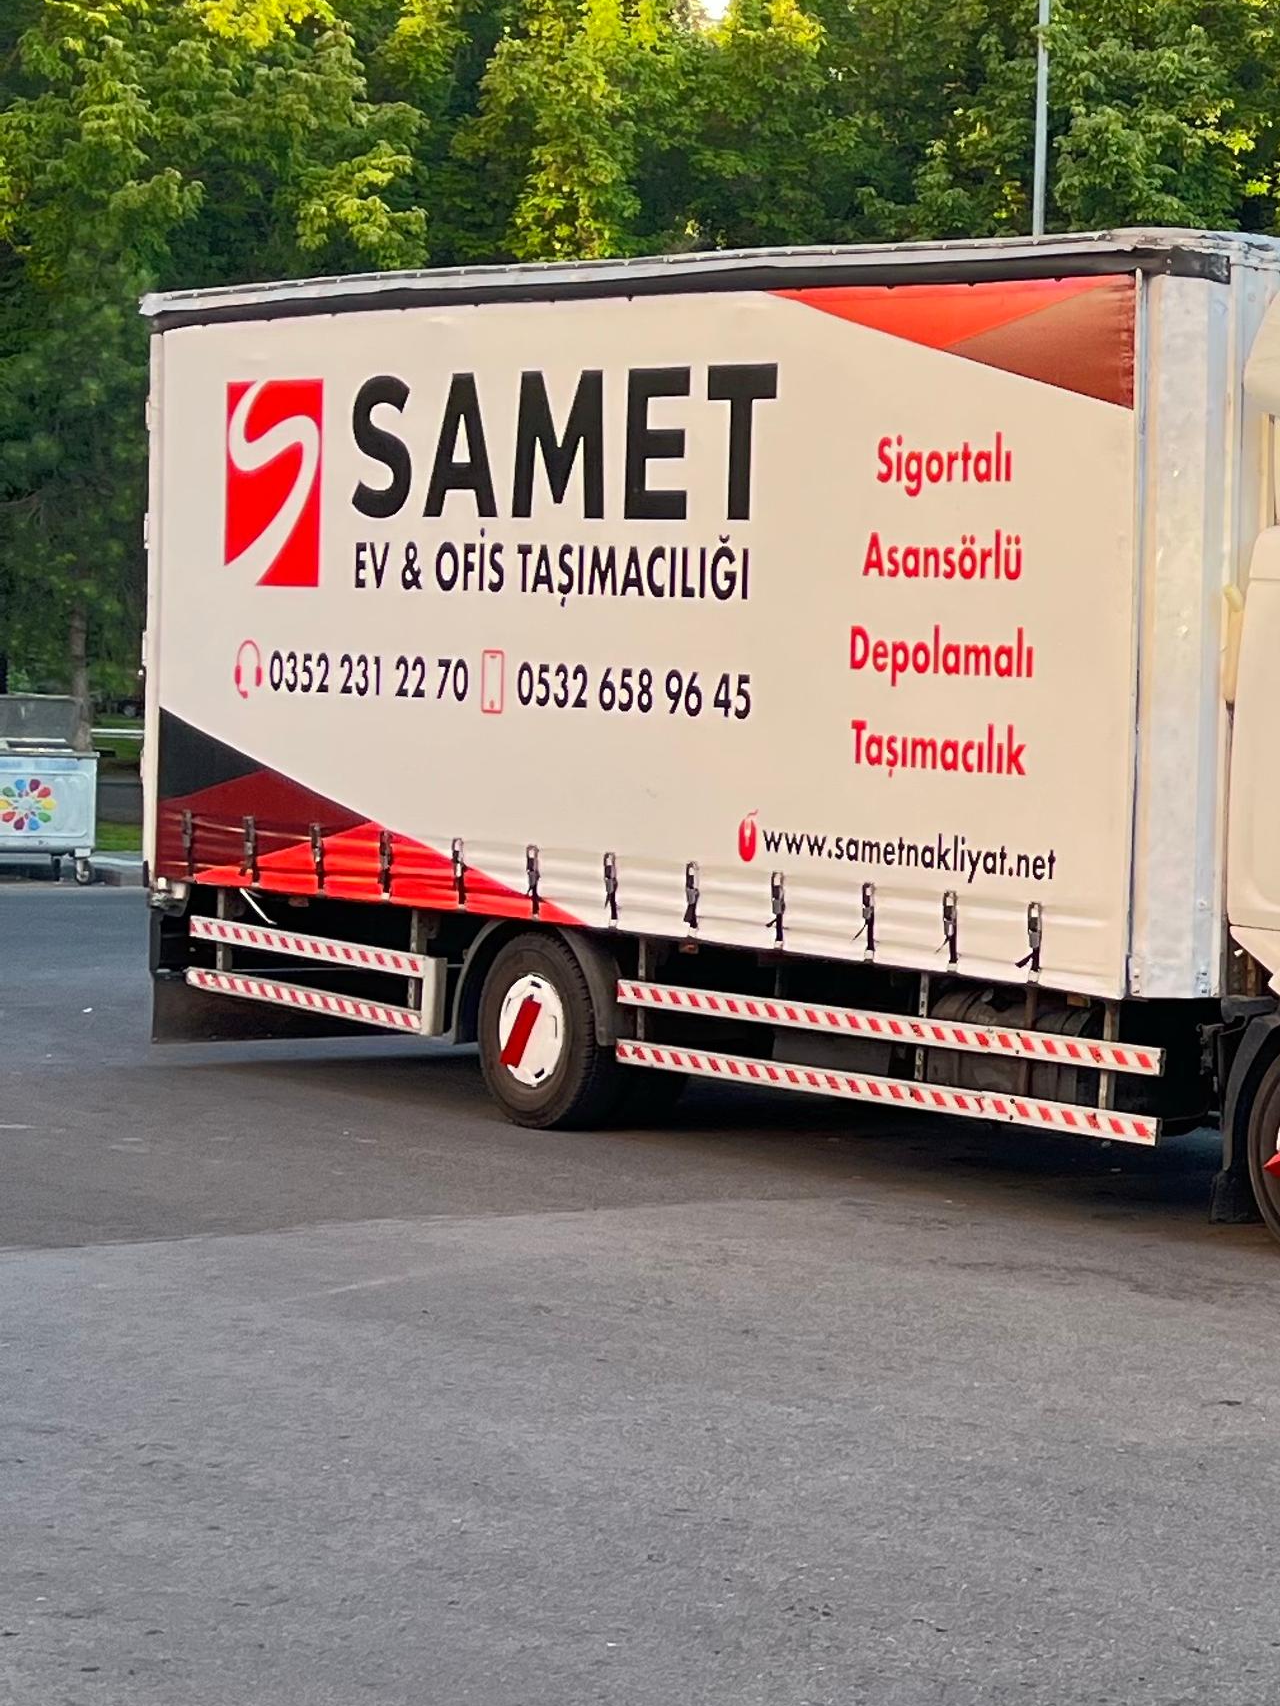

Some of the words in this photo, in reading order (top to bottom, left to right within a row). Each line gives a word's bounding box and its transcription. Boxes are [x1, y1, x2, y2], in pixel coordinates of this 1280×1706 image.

[352, 362, 778, 521] SAMET
[876, 431, 1012, 497] Sigortalı
[354, 541, 389, 589] EV
[401, 541, 422, 591] &
[435, 528, 504, 593] OFİS
[517, 534, 749, 607] TAŞIMACILIĞI
[862, 529, 1023, 580] Asansörlü
[269, 649, 330, 693] 0352
[339, 654, 382, 697] 231
[395, 655, 426, 699] 22
[435, 657, 469, 701] 70
[517, 661, 588, 709] 0532
[599, 666, 653, 713] 658
[665, 668, 703, 717] 96
[713, 672, 752, 720] 45
[850, 625, 1034, 686] Depolamalı
[851, 720, 1027, 777] Taşımacılık
[762, 829, 1057, 884] www.sametnakliyat.net
